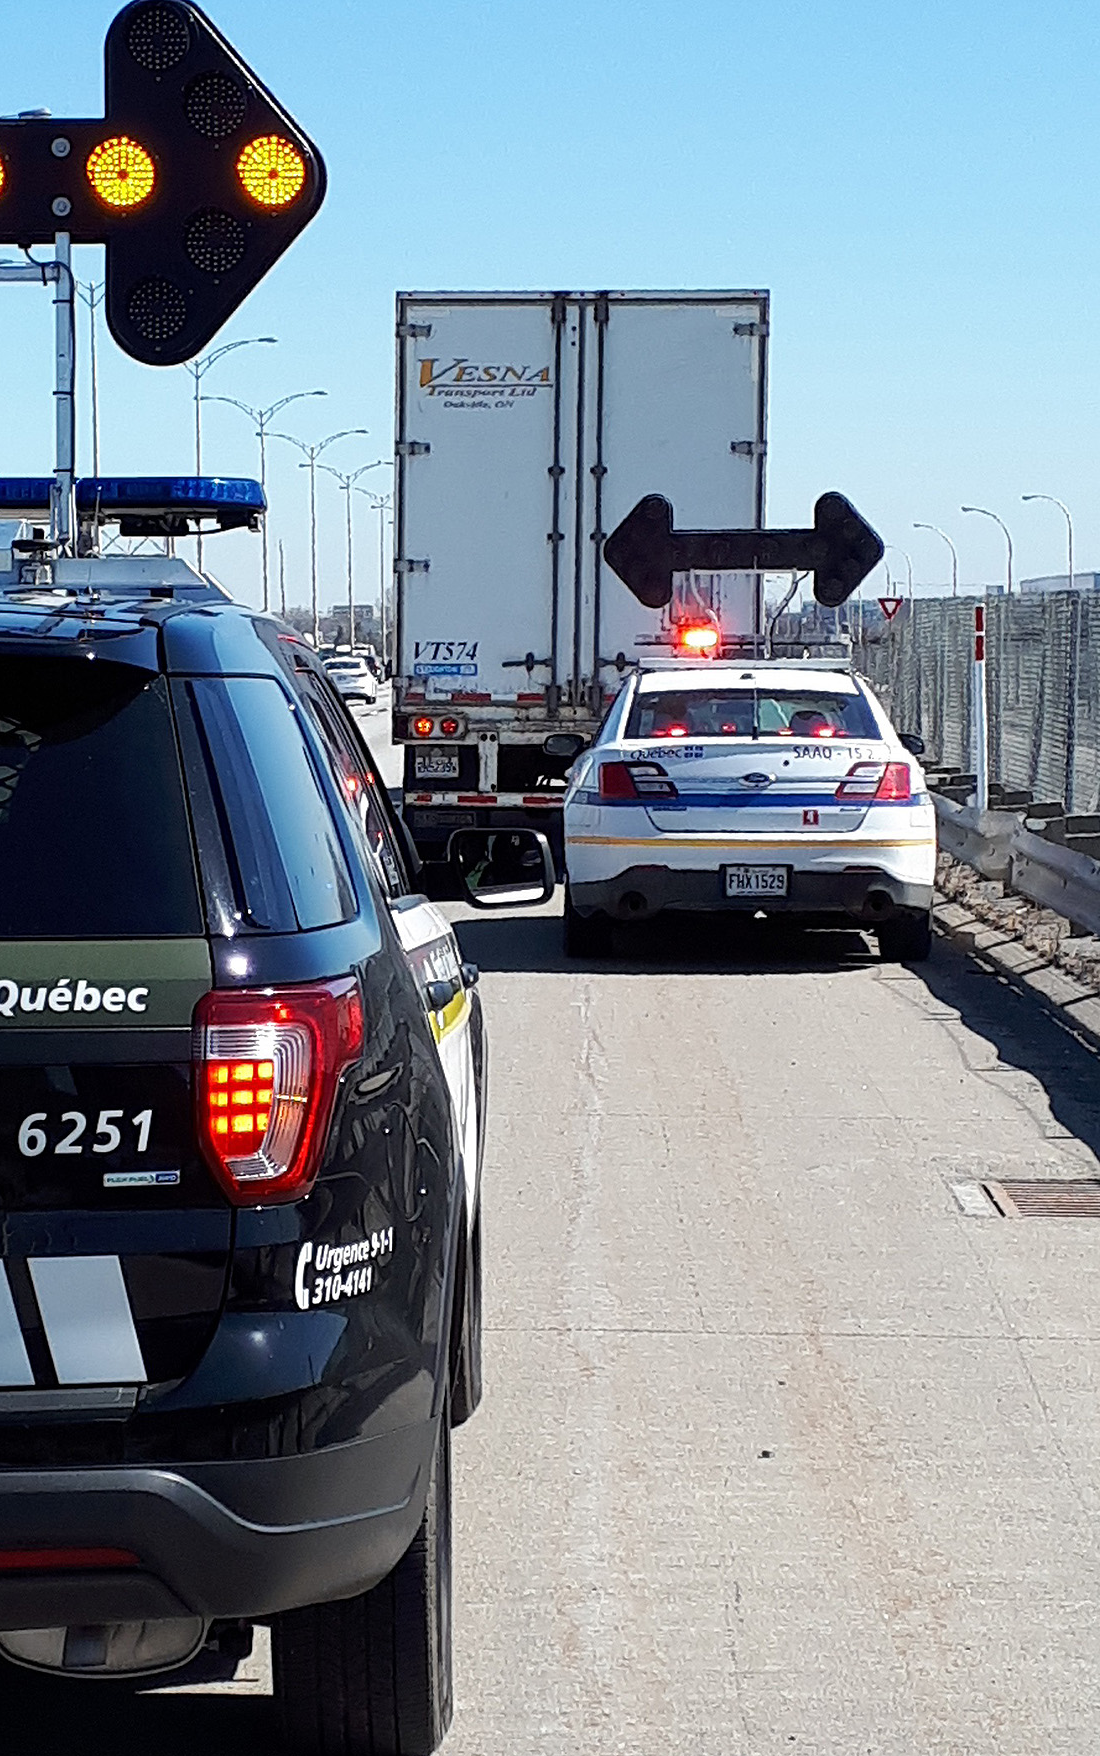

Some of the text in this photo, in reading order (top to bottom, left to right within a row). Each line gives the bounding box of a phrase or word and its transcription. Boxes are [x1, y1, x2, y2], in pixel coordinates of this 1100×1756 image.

[418, 358, 550, 389] VESNA
[428, 386, 505, 399] Transport
[413, 641, 479, 661] VT574
[793, 745, 833, 760] SAAQ
[729, 873, 785, 890] FHX1529
[18, 1109, 153, 1158] 6251
[315, 1226, 394, 1274] Urgence 9-1-1
[311, 1264, 373, 1305] 310-4141
